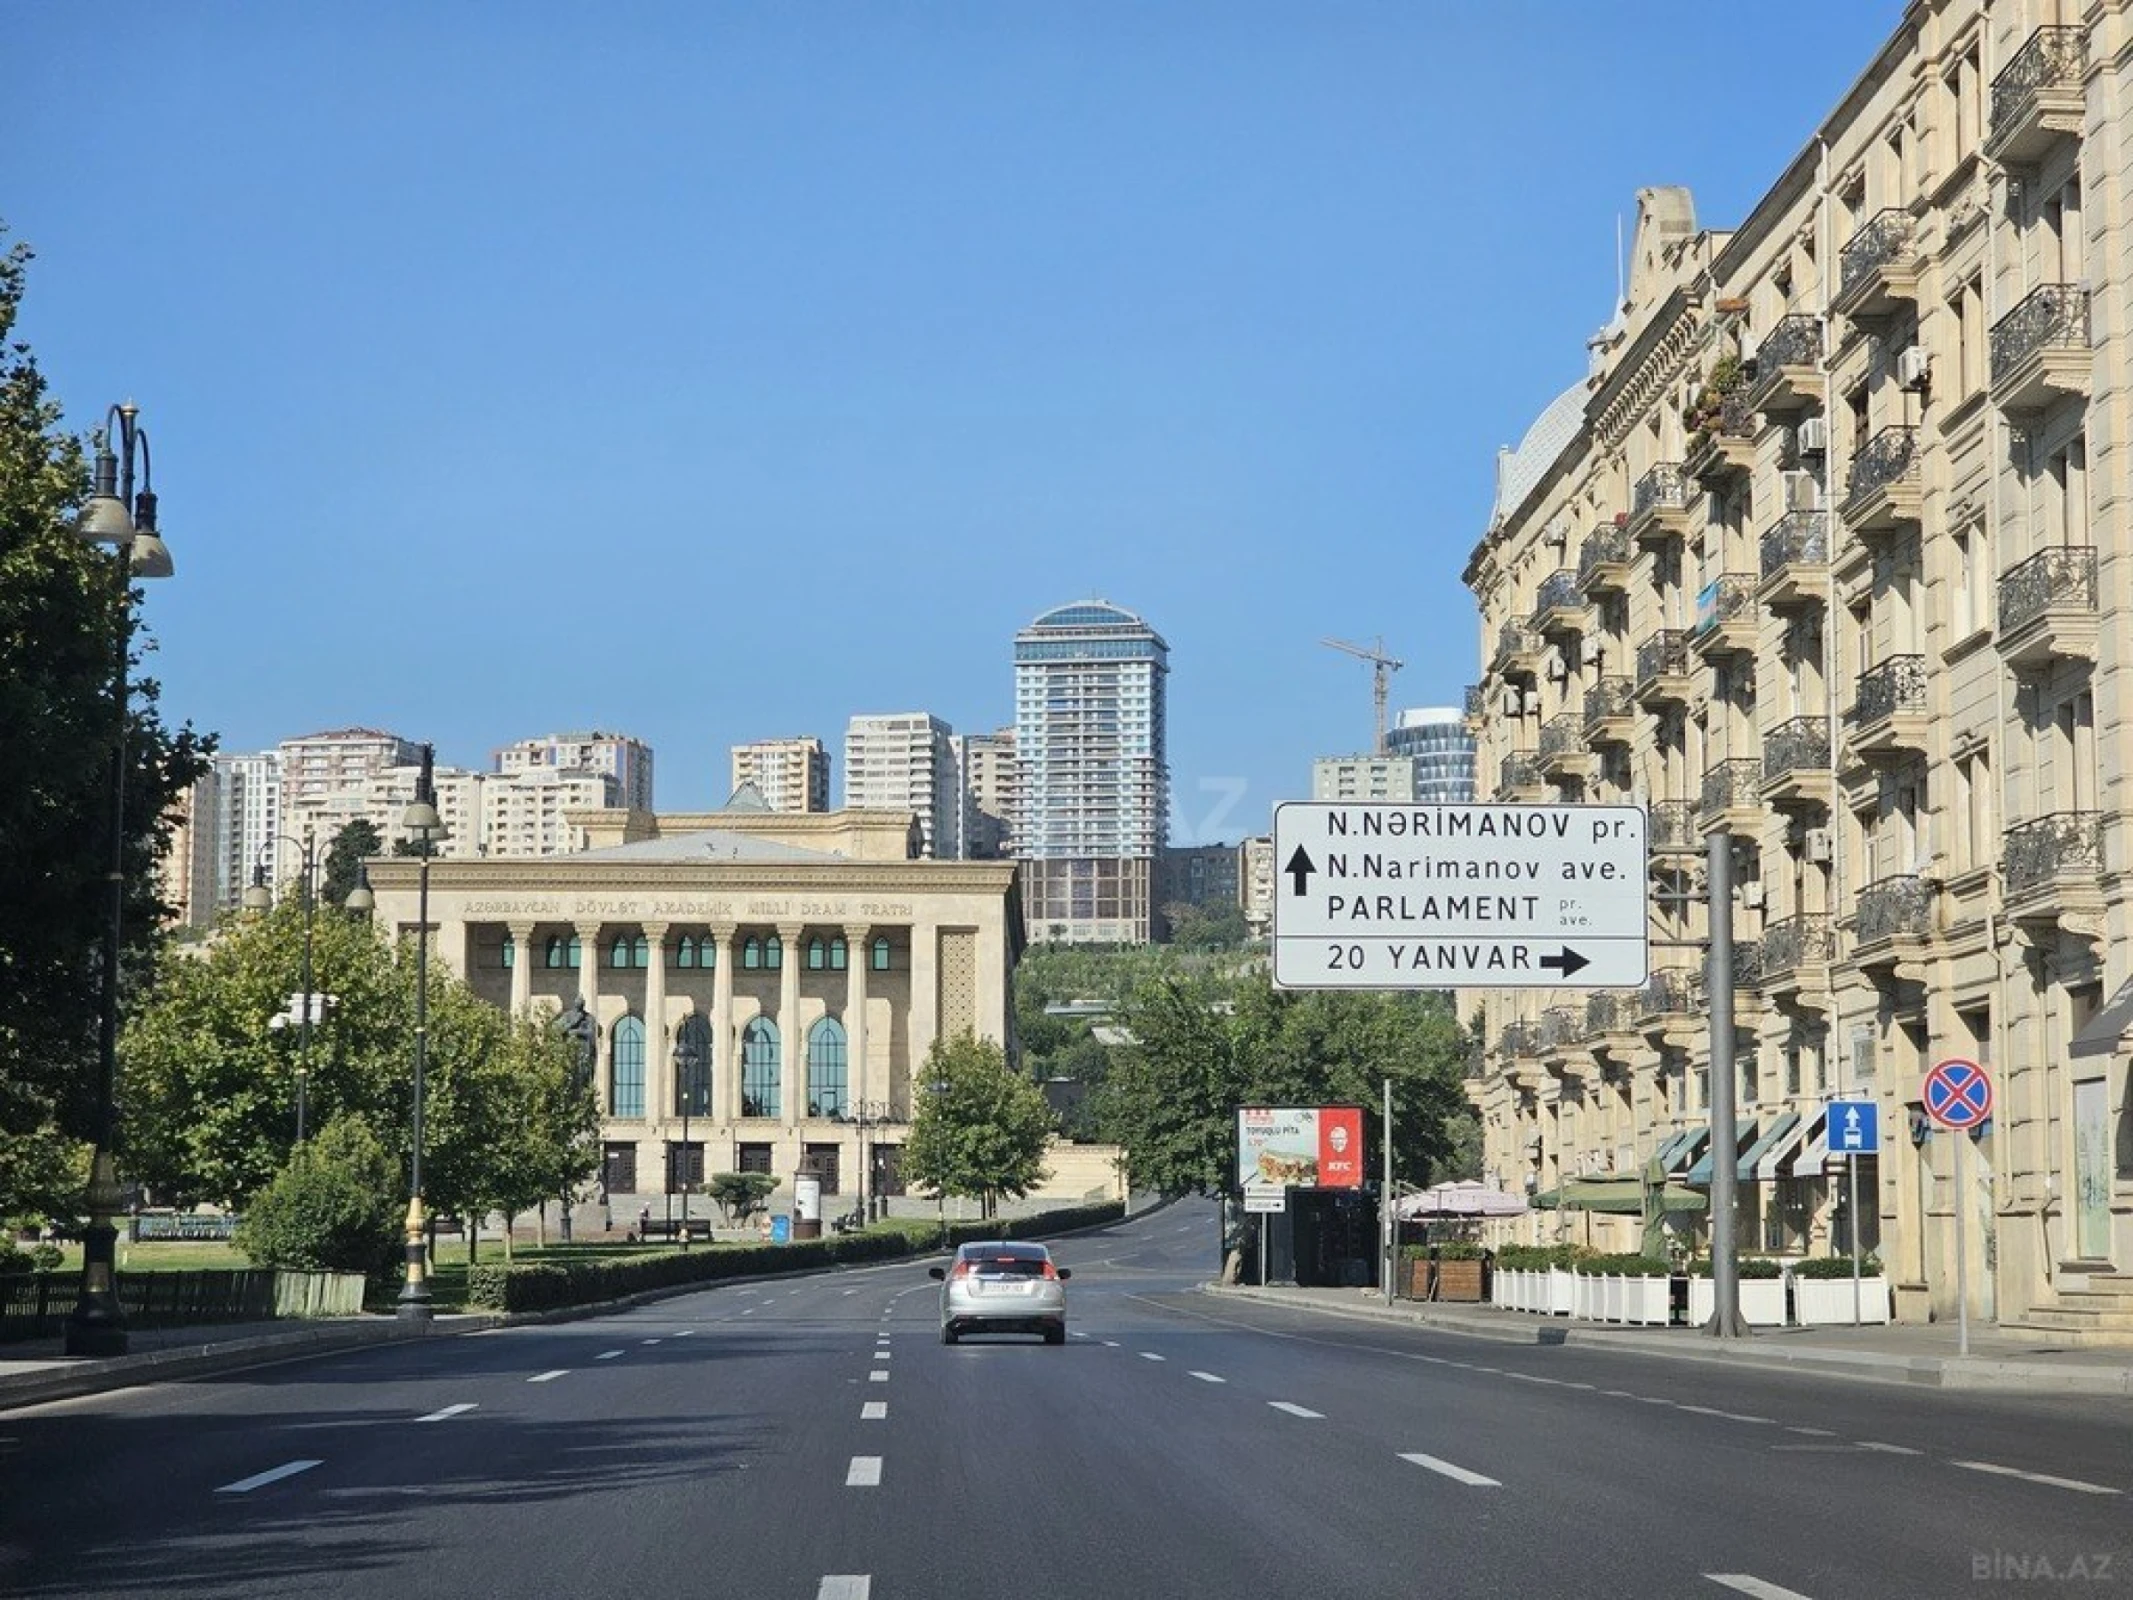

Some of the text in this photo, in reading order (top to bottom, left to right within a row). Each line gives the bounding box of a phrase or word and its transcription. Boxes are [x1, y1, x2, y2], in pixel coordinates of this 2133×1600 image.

[1327, 808, 1637, 844] N.NƏRİMANOV pr.
[1327, 854, 1627, 880] N.Narimanov ave.
[1327, 896, 1540, 920] PARLAMENT
[1559, 899, 1582, 911] pr.
[1559, 916, 1592, 927] ave.
[1328, 945, 1531, 970] 20 YANVAR
